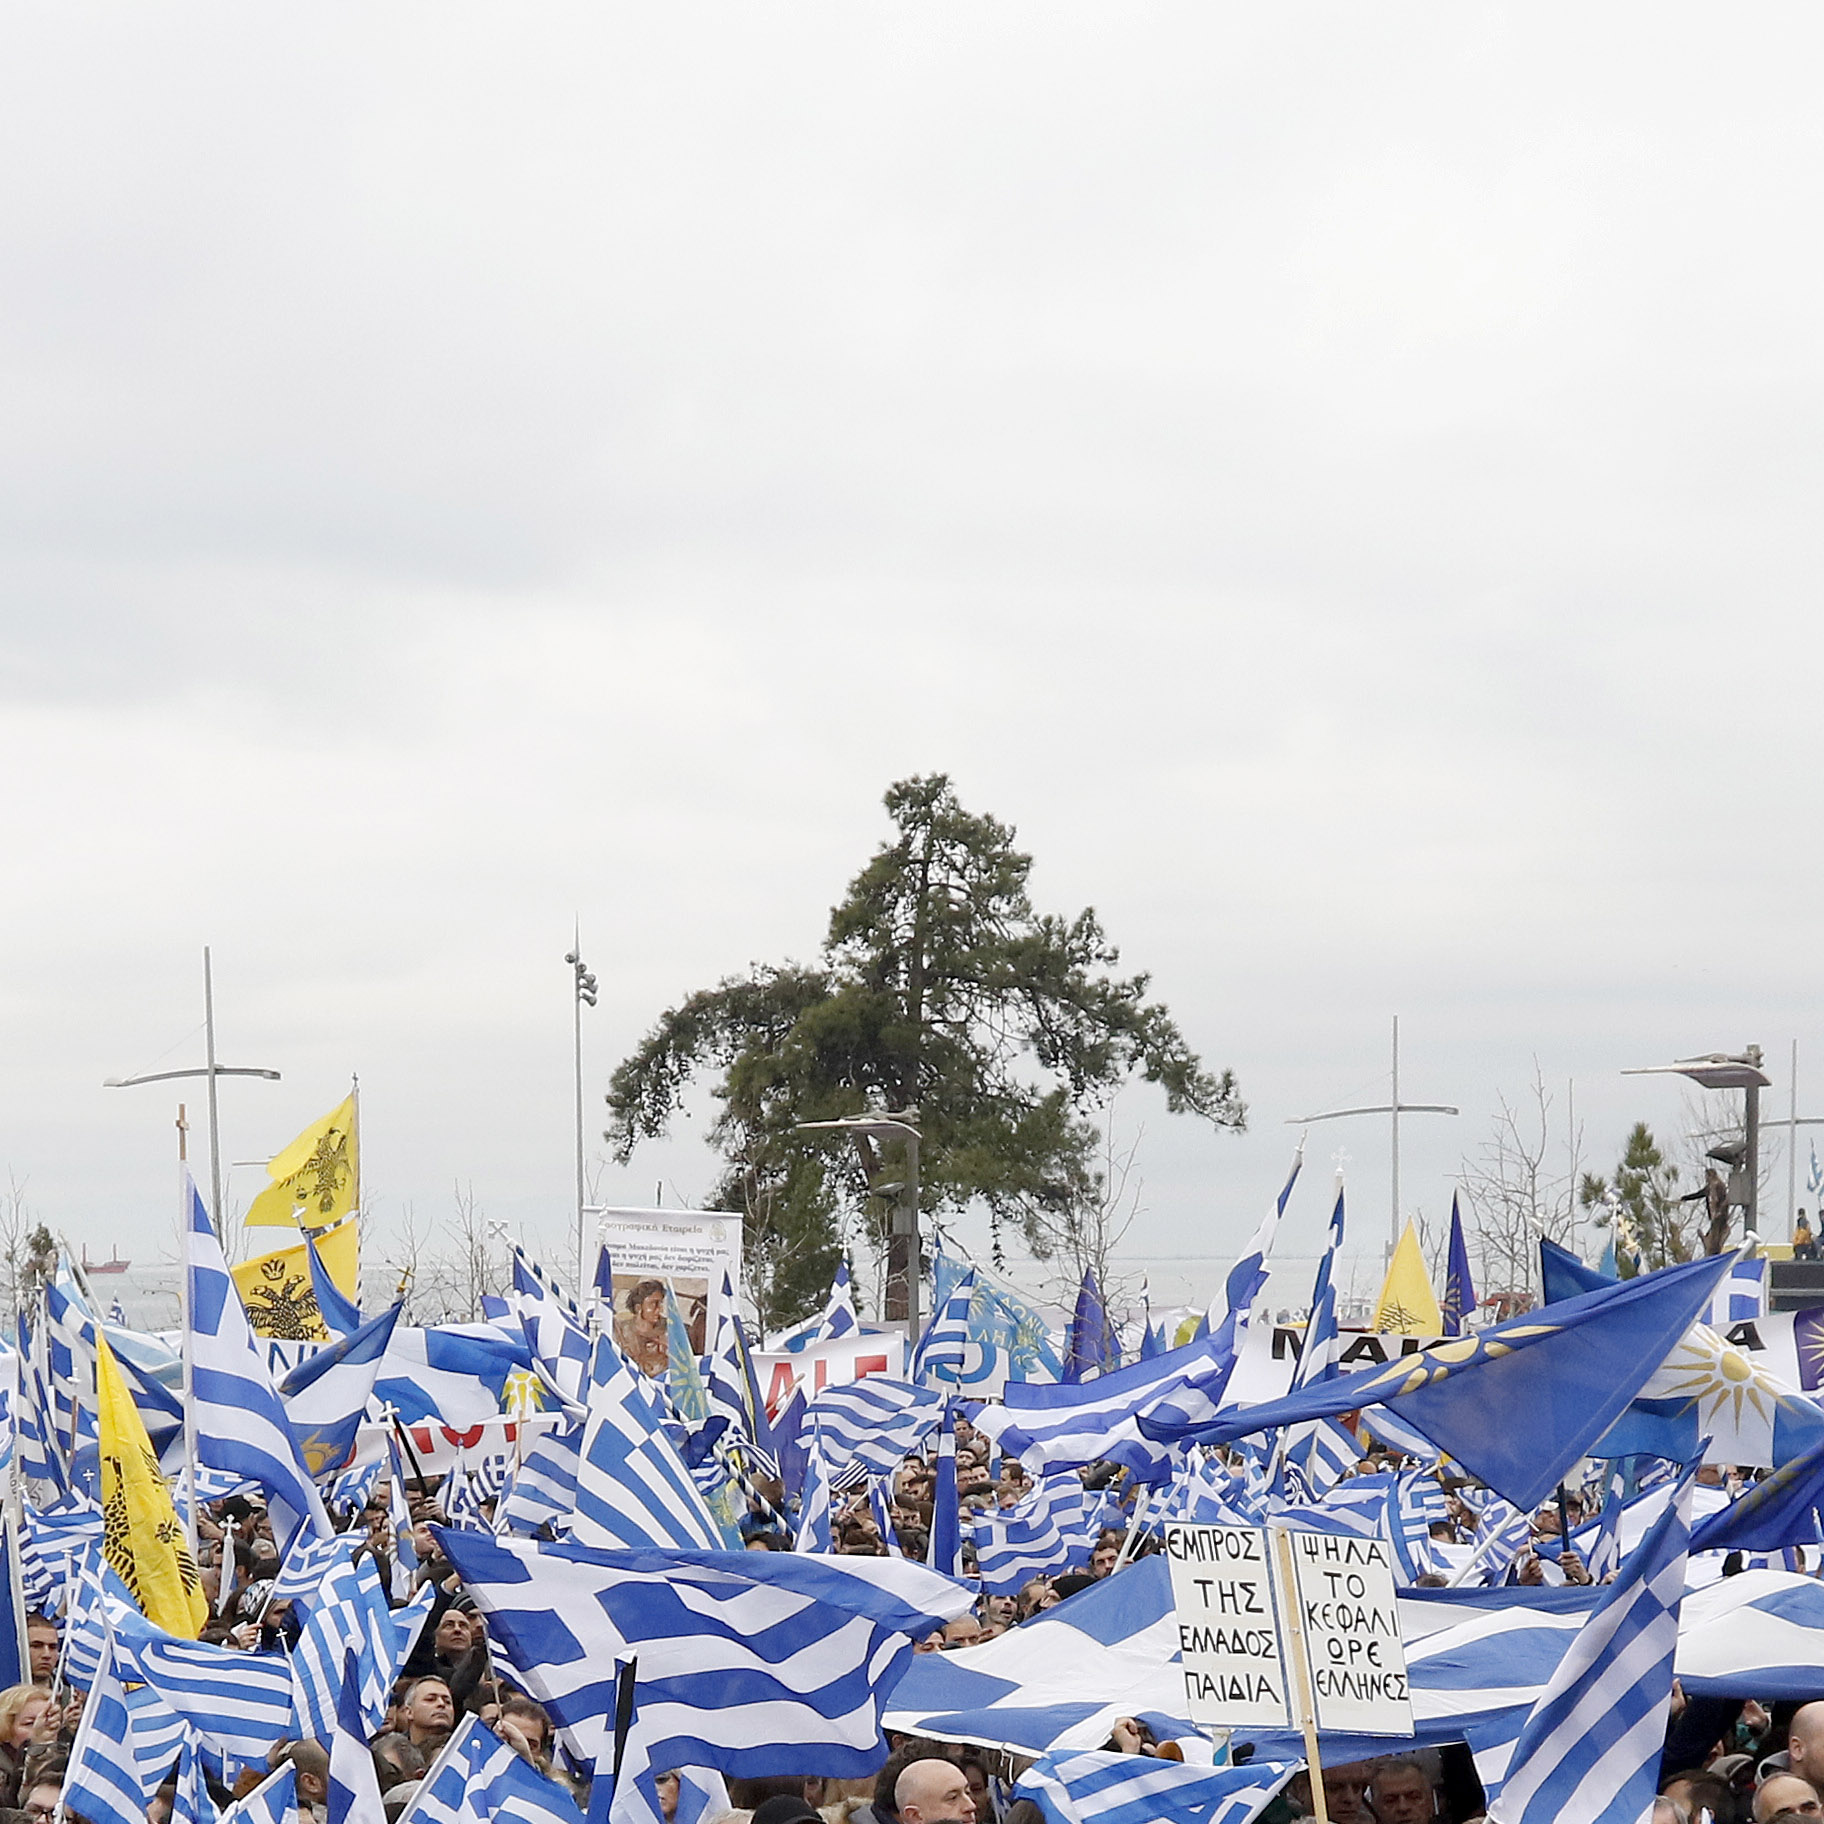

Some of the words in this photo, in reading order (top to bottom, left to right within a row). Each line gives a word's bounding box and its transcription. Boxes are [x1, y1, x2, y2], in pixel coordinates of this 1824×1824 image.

[603, 1222, 658, 1234] αογραφική
[1167, 1528, 1262, 1563] ΕΜΠΡΟΣ
[1302, 1535, 1389, 1569] ΨΗΛΑ
[1193, 1579, 1265, 1615] ΤΗΣ
[1322, 1571, 1366, 1600] ΤΟ
[1305, 1601, 1399, 1637] ΚΕΦΑΛΙ
[1178, 1624, 1277, 1660] ΕΛΛΑΔΟΣ
[1327, 1637, 1383, 1668] ΩΡΕ
[1184, 1672, 1282, 1704] ΠΑΙΔΙΑ
[1315, 1669, 1409, 1702] ΕΛΛΗΝΕΣ
